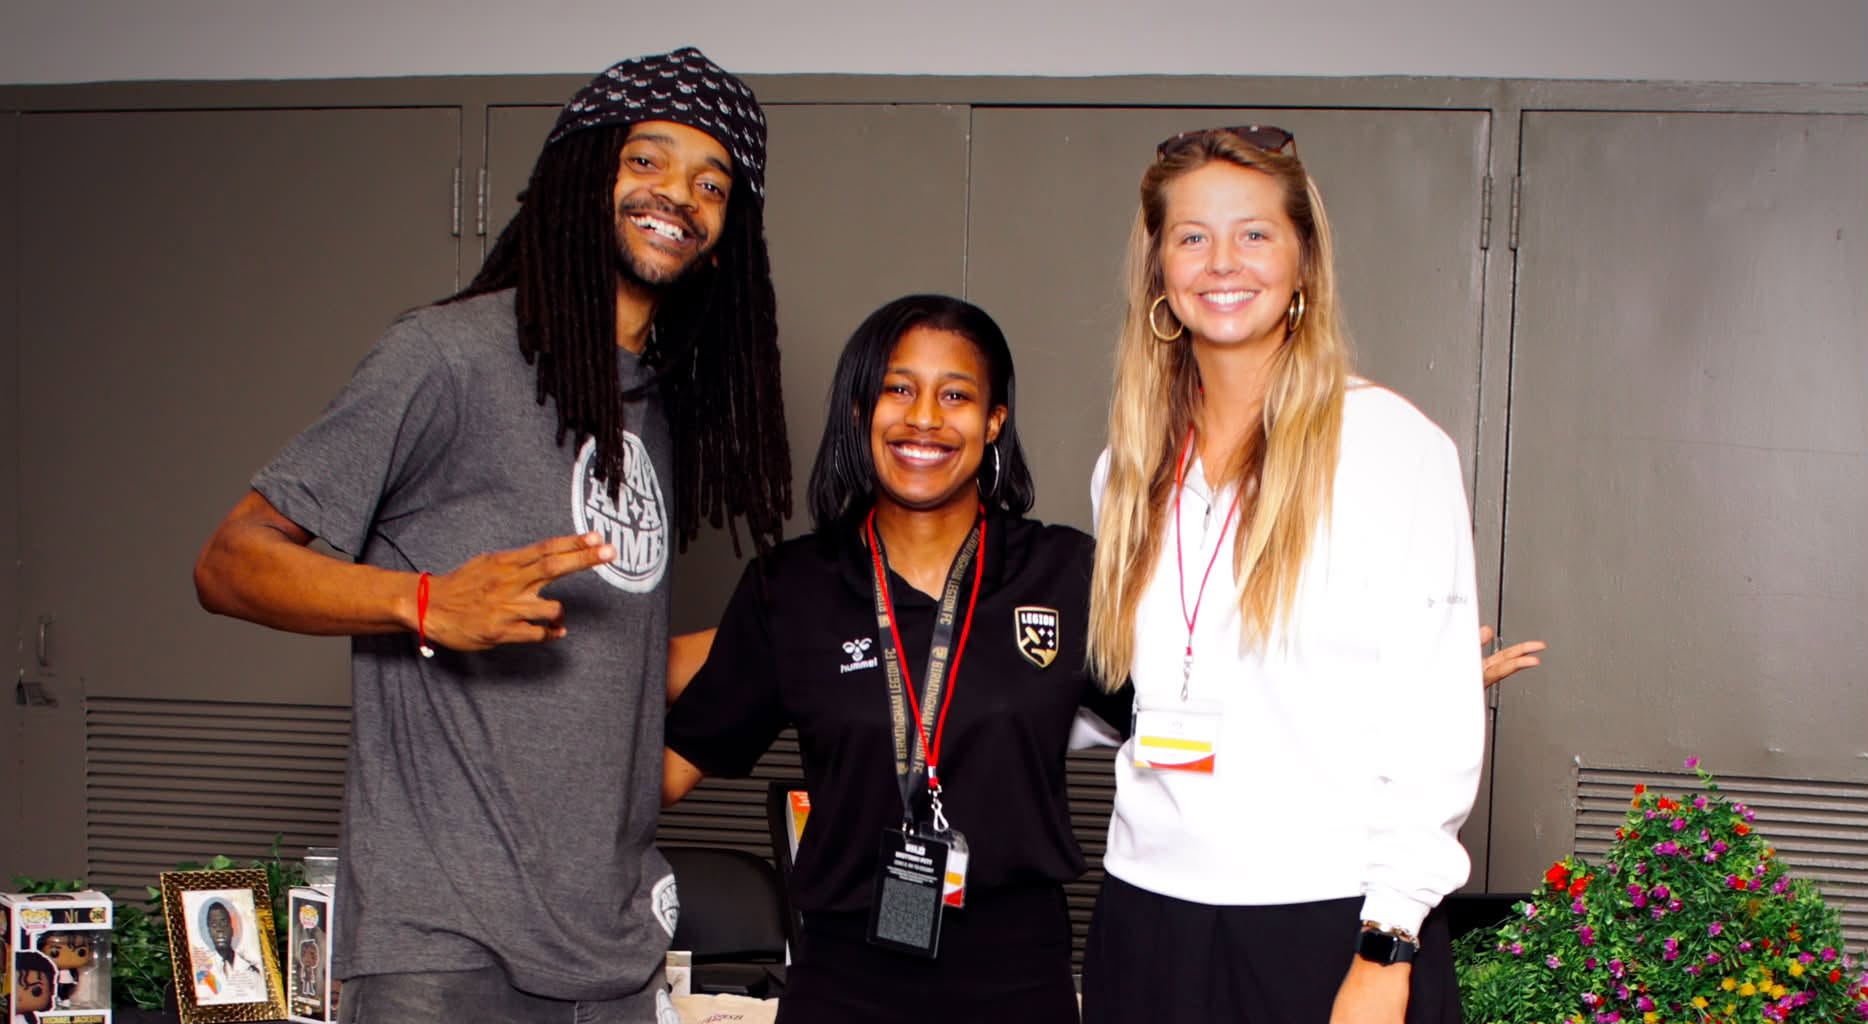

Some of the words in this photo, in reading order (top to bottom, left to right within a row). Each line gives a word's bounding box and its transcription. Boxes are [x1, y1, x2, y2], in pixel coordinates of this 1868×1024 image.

[639, 499, 663, 531] A
[586, 504, 664, 576] TIME
[943, 580, 961, 612] LEGION
[940, 613, 953, 626] FC
[1021, 612, 1055, 628] LEGION
[840, 646, 878, 674] hummel
[884, 647, 897, 660] FC
[886, 661, 902, 694] LEGION
[921, 661, 945, 726] BIRMINGHAM
[890, 694, 908, 760] BIRMINGHAM
[915, 725, 934, 760] LEION
[913, 762, 925, 776] FC
